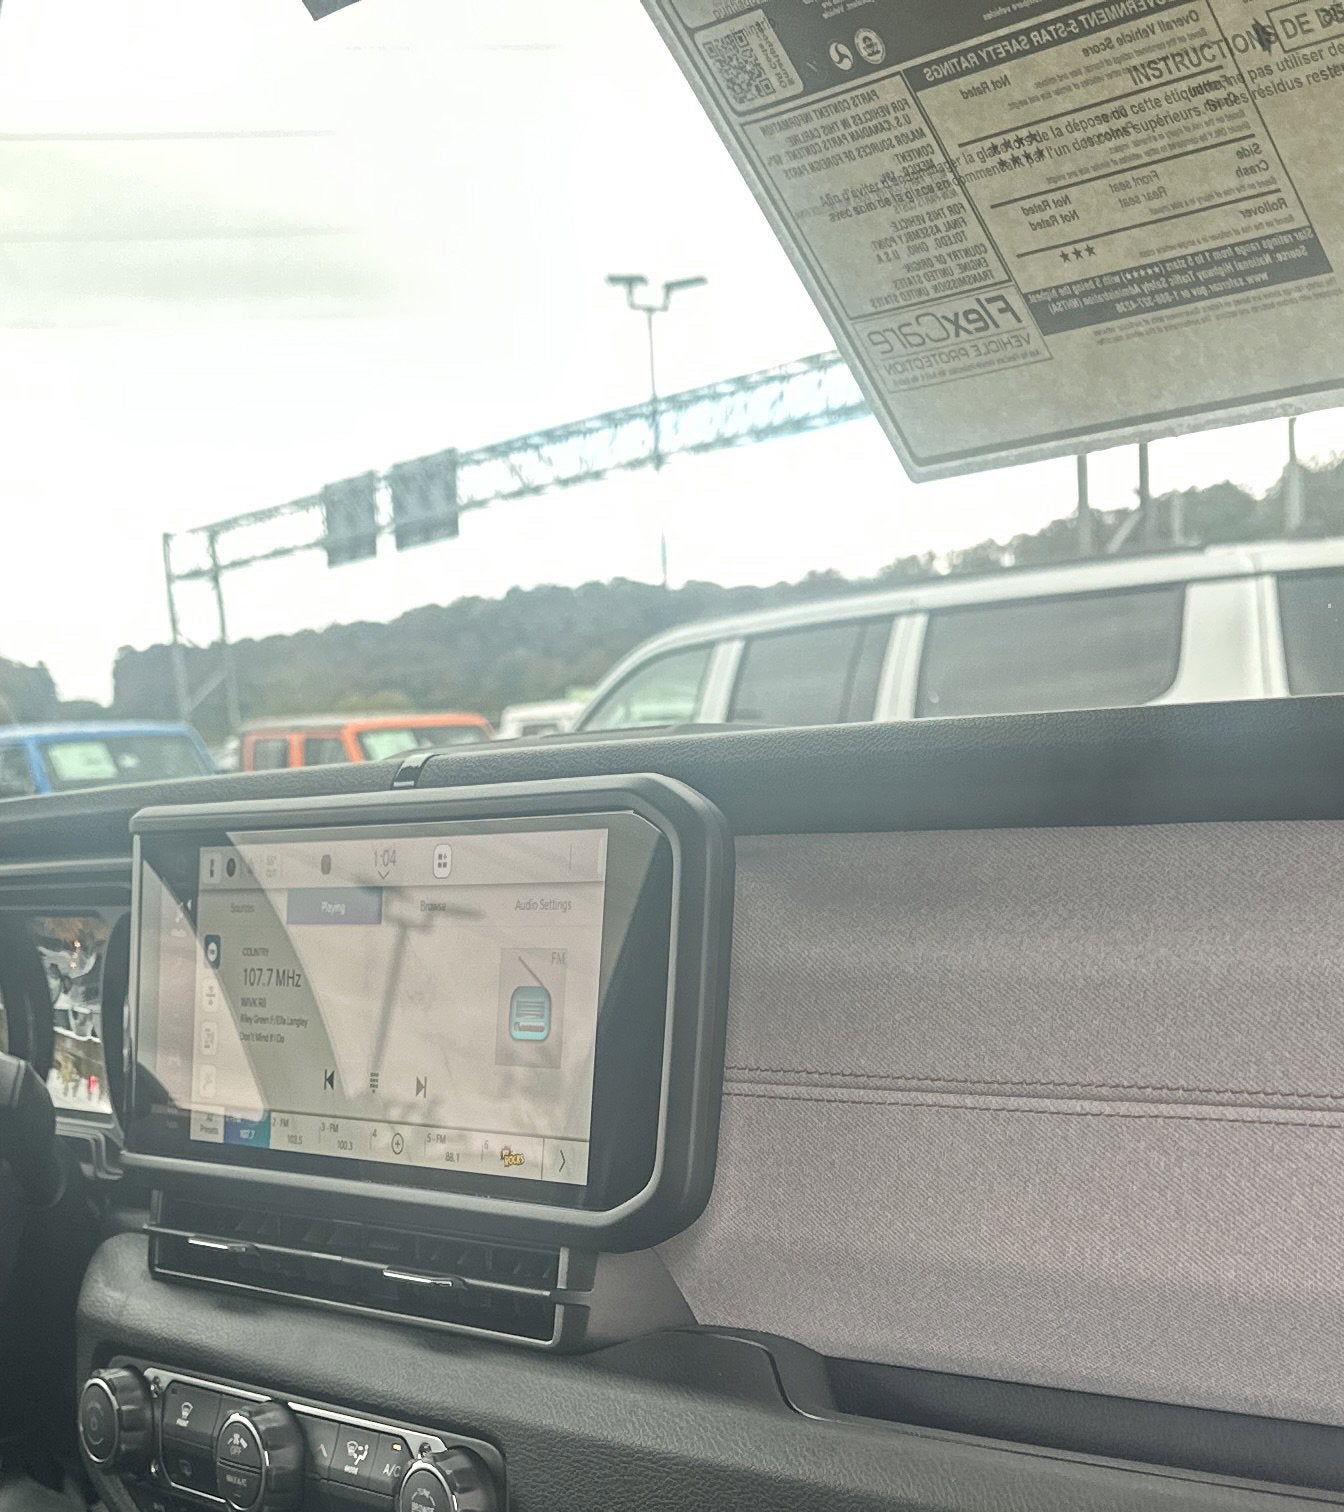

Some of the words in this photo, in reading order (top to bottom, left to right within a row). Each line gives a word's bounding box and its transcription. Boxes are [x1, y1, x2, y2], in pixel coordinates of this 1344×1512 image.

[1279, 12, 1313, 40] DE
[1050, 123, 1065, 139] la
[1130, 93, 1162, 115] cette
[1247, 62, 1272, 81] pas
[1275, 48, 1318, 72] utiliser
[373, 849, 397, 867] 1:04
[321, 901, 346, 916] Playing
[420, 899, 447, 912] Browse
[515, 899, 539, 911] Audio
[539, 898, 572, 913] Settings
[243, 968, 274, 987] 107.7
[275, 968, 302, 988] MHz
[382, 1463, 401, 1478] A/C
